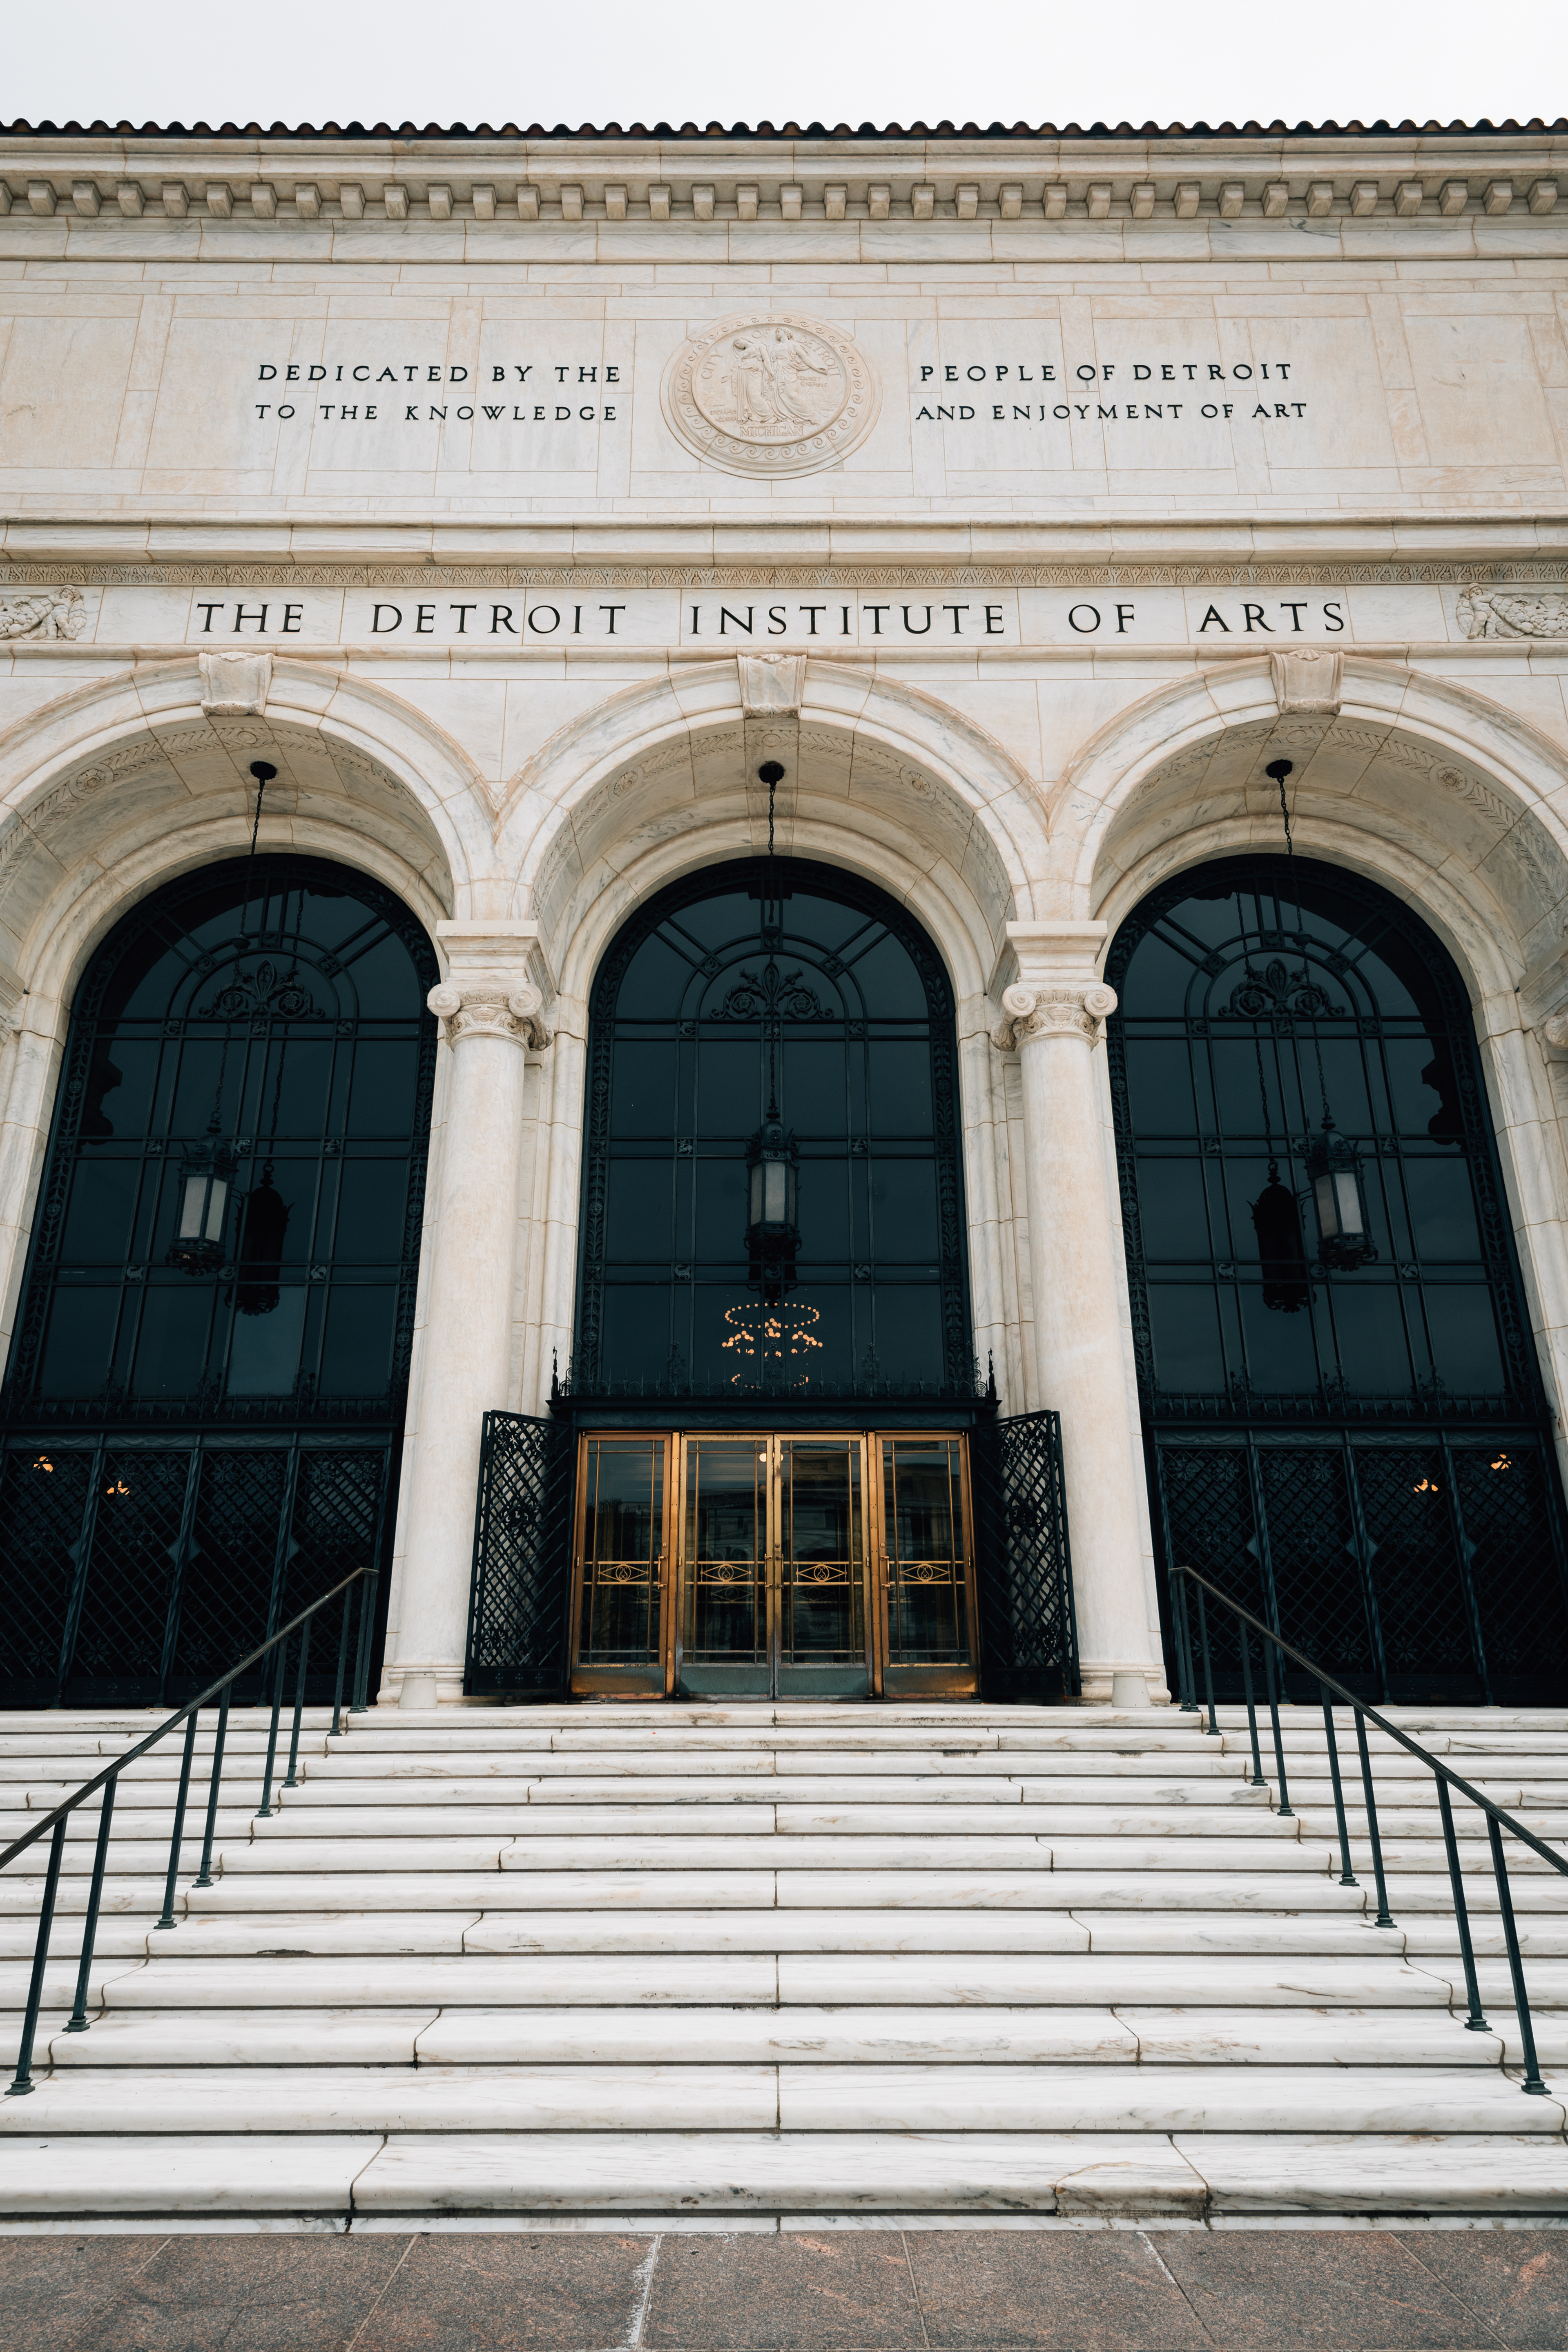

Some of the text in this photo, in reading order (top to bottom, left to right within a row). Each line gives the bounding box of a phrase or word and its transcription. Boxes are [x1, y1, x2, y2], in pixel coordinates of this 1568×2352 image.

[701, 329, 842, 379] CITY OF DETROIT
[258, 364, 1291, 382] DEDICATED BY THE PEOPLE OF DETROIT
[255, 403, 1307, 421] TO THE KNOWLEDGE AND ENJOYMENT OF ART
[740, 426, 804, 437] MICHIGAN
[197, 602, 1344, 635] THE DETROIT INSTITUTE OF ARTS
